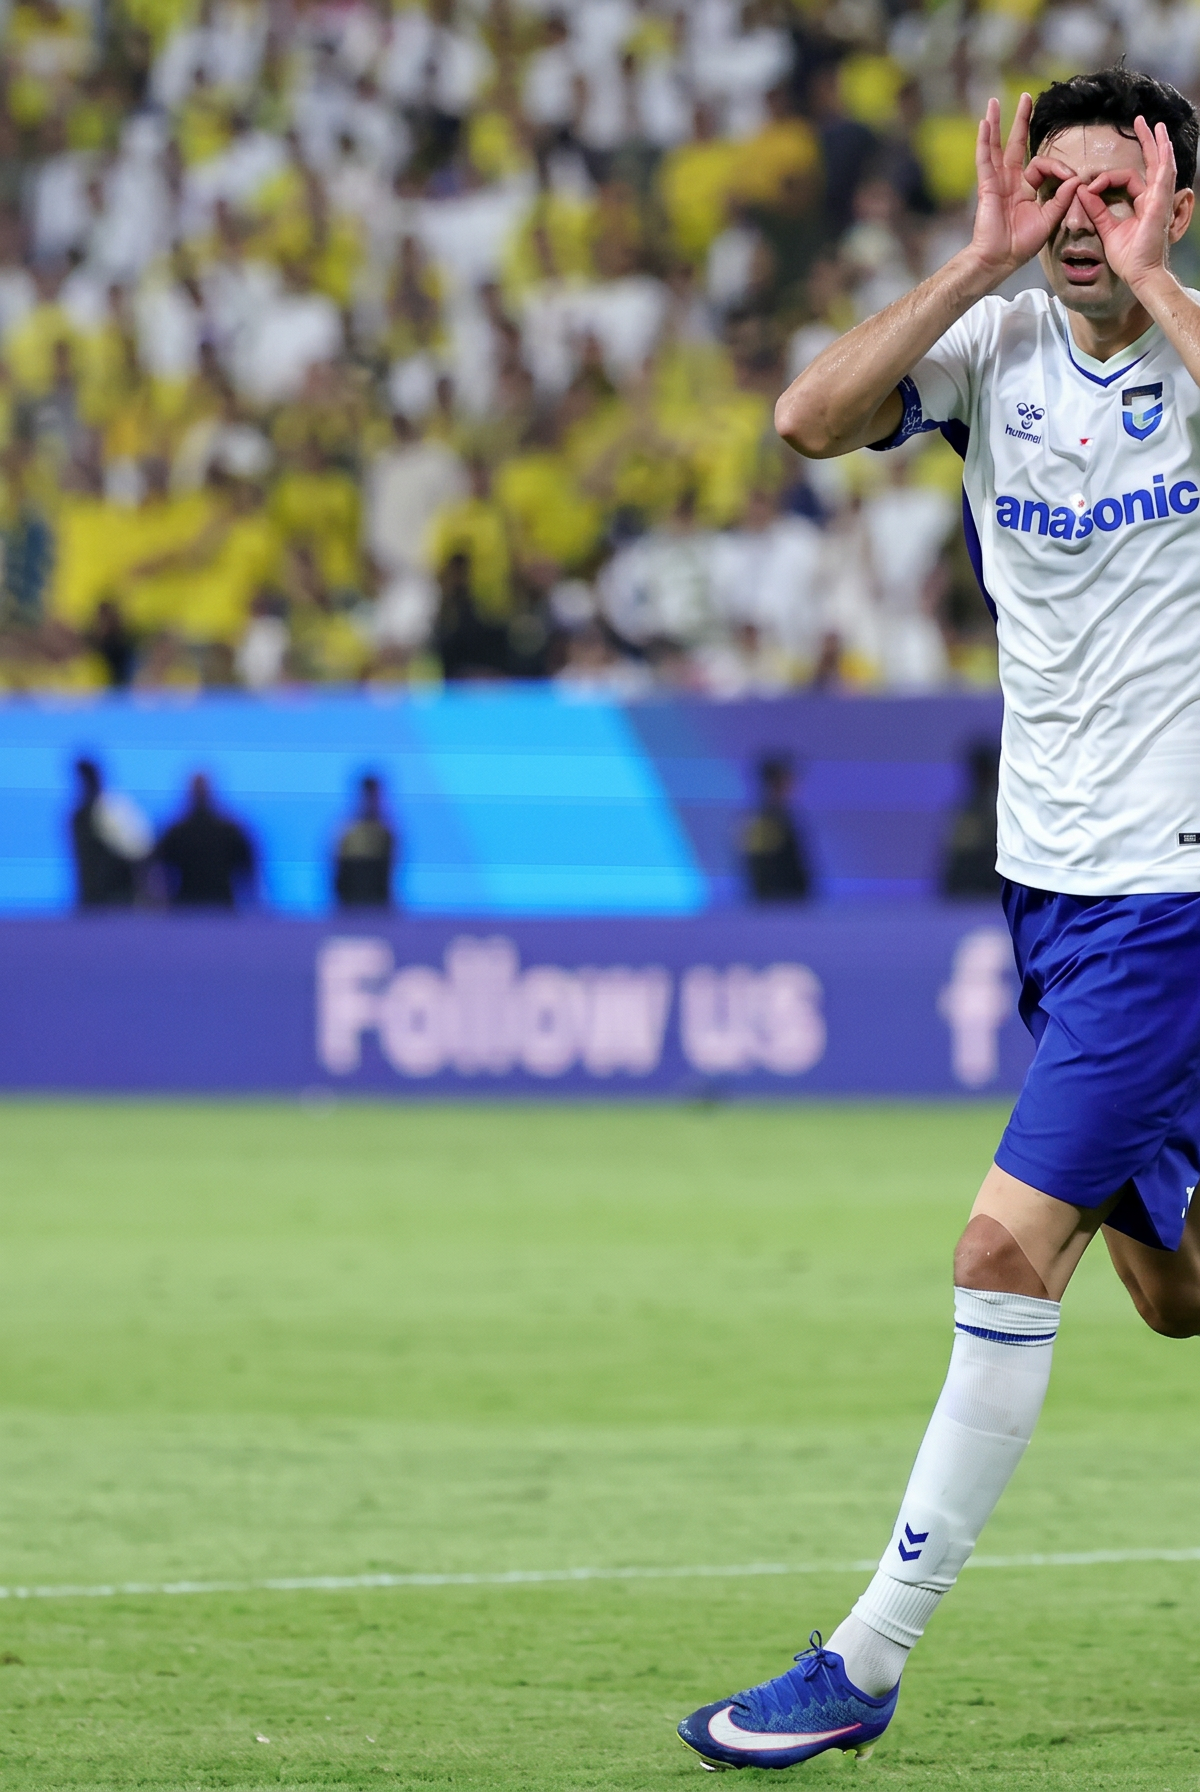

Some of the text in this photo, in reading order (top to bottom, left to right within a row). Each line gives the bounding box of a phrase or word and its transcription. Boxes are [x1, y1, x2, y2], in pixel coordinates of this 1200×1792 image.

[1004, 423, 1042, 445] hummel
[995, 473, 1200, 541] anasonic
[316, 934, 827, 1078] Follow us
